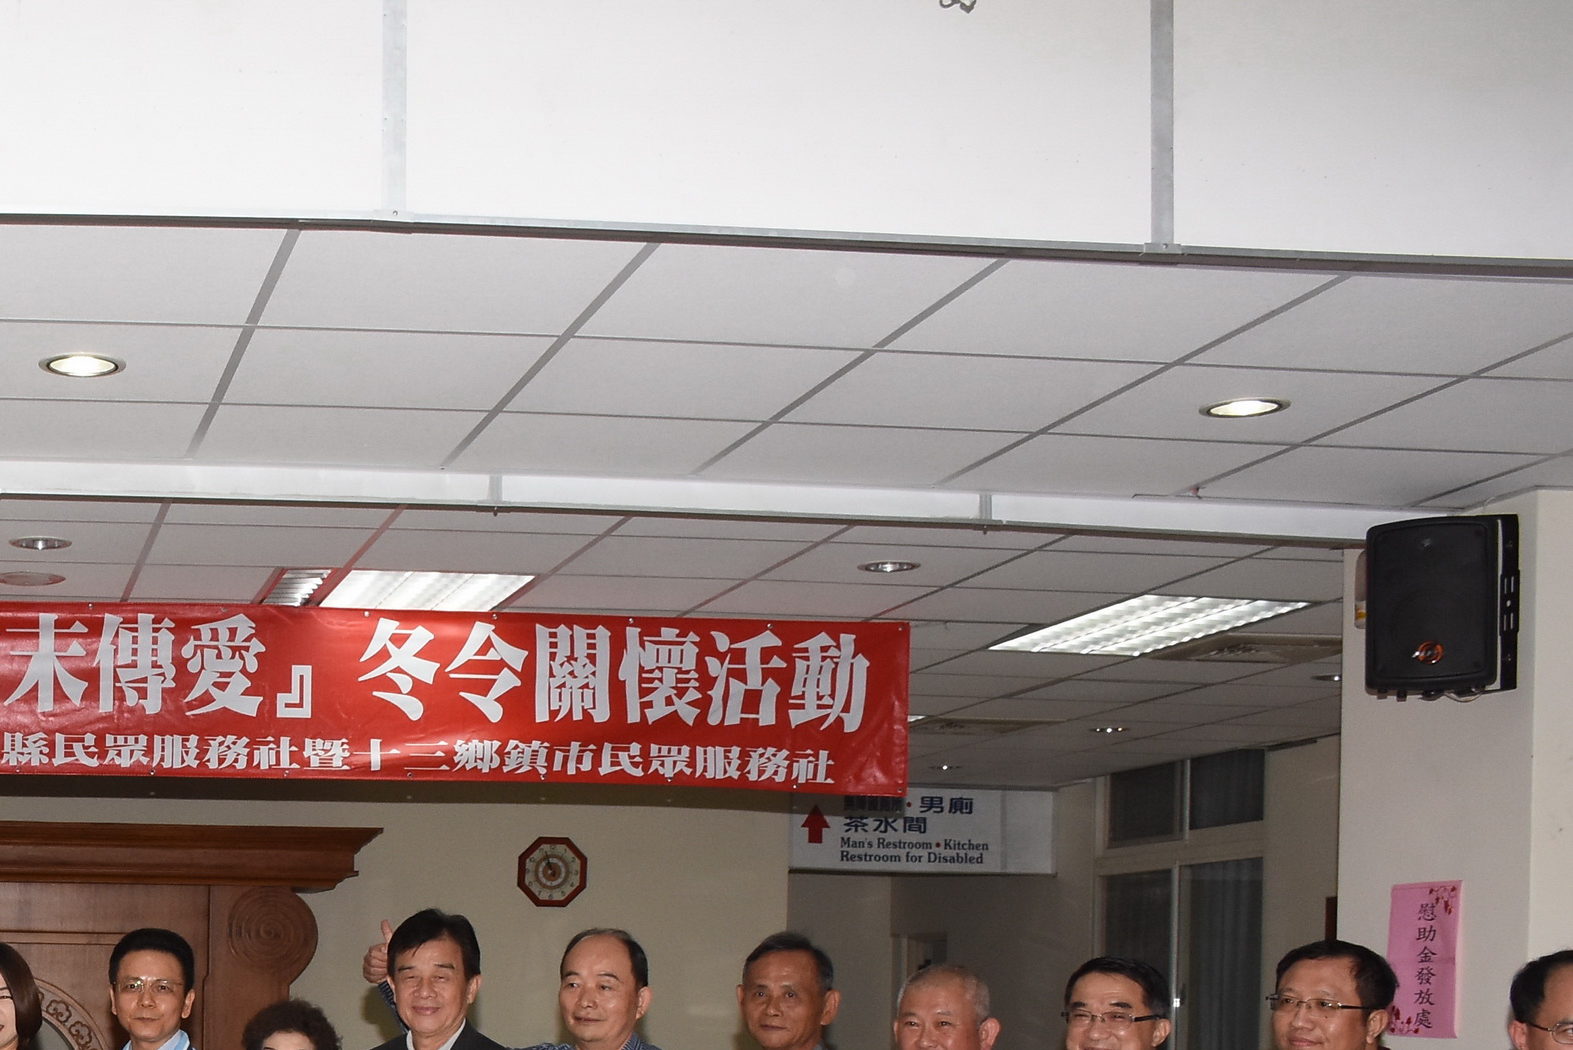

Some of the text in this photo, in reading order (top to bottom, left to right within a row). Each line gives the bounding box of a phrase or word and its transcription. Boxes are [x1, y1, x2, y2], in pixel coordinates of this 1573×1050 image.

[843, 816, 927, 834] 茶水間
[840, 837, 990, 851] Man's Restroom Kitchen
[840, 850, 984, 865] Restroom for Disabled
[1414, 903, 1437, 1029] 慰助金發放處
